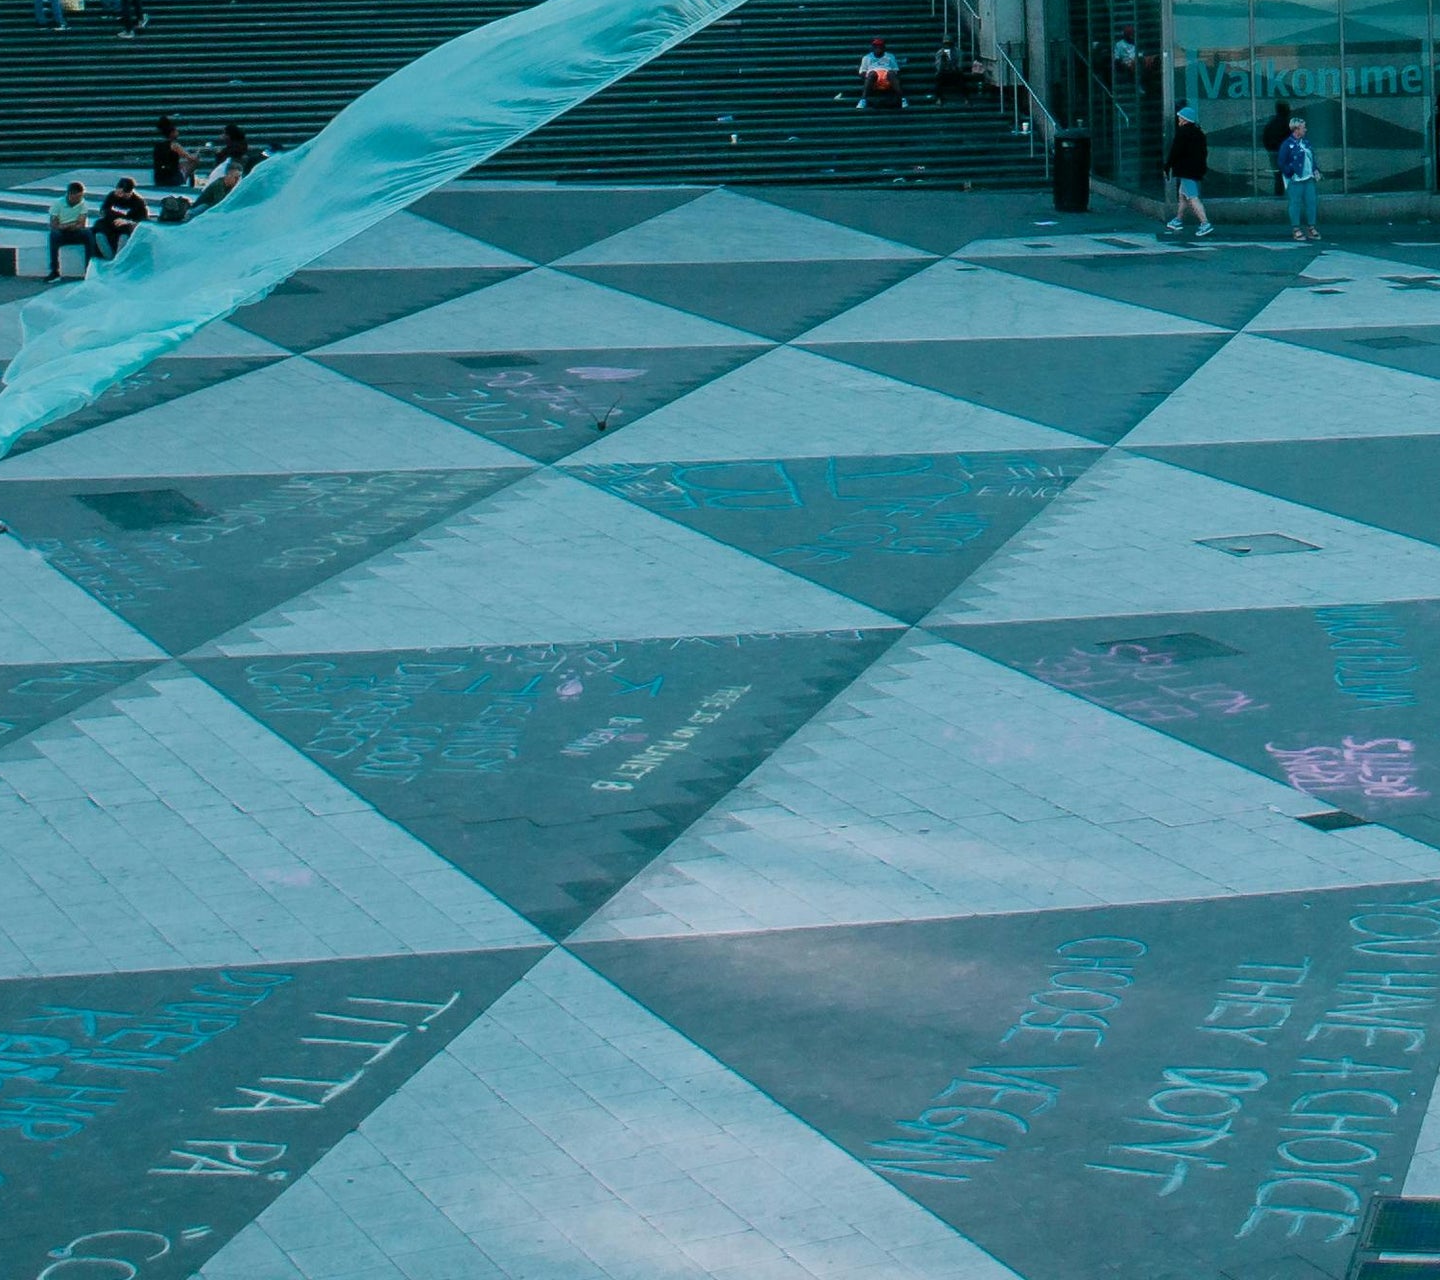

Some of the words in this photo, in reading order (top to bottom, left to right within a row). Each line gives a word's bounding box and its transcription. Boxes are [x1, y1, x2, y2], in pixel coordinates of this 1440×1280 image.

[999, 936, 1149, 1049] CHOOSE
[1195, 955, 1313, 1047] THEY
[1306, 971, 1440, 1052] HAVE
[212, 989, 461, 1113] TITTA
[1291, 1056, 1411, 1081] A
[146, 1138, 289, 1182] PÅ
[863, 1061, 1088, 1184] VEGAN
[1234, 1090, 1402, 1244] CHOICE
